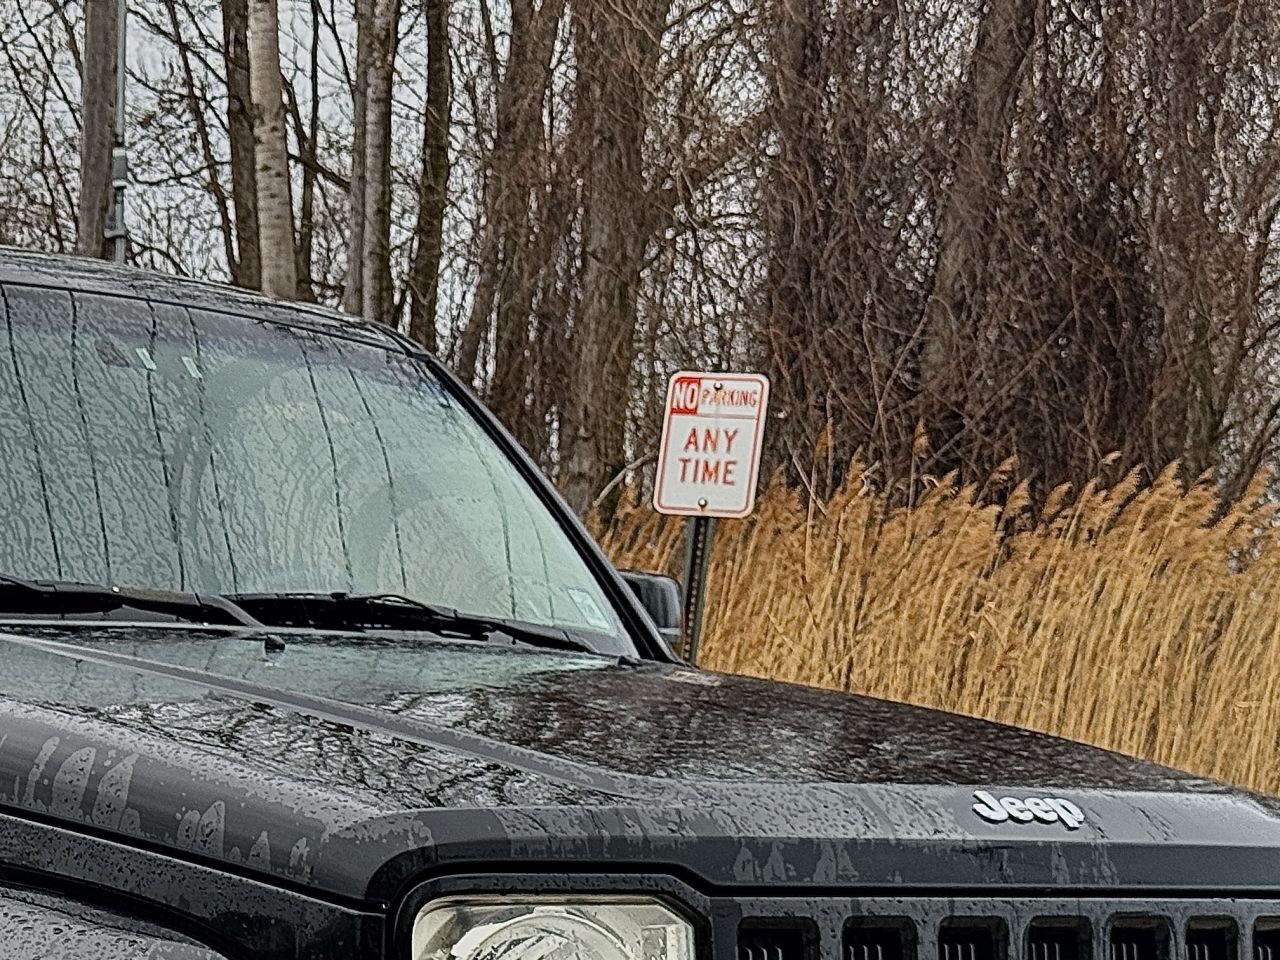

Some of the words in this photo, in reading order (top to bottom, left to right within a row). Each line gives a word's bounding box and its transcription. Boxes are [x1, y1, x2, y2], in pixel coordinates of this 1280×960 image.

[672, 381, 698, 411] NO
[700, 388, 757, 407] PARKING
[683, 428, 738, 453] ANY
[678, 458, 738, 486] TIME
[972, 790, 1085, 830] Jeep
